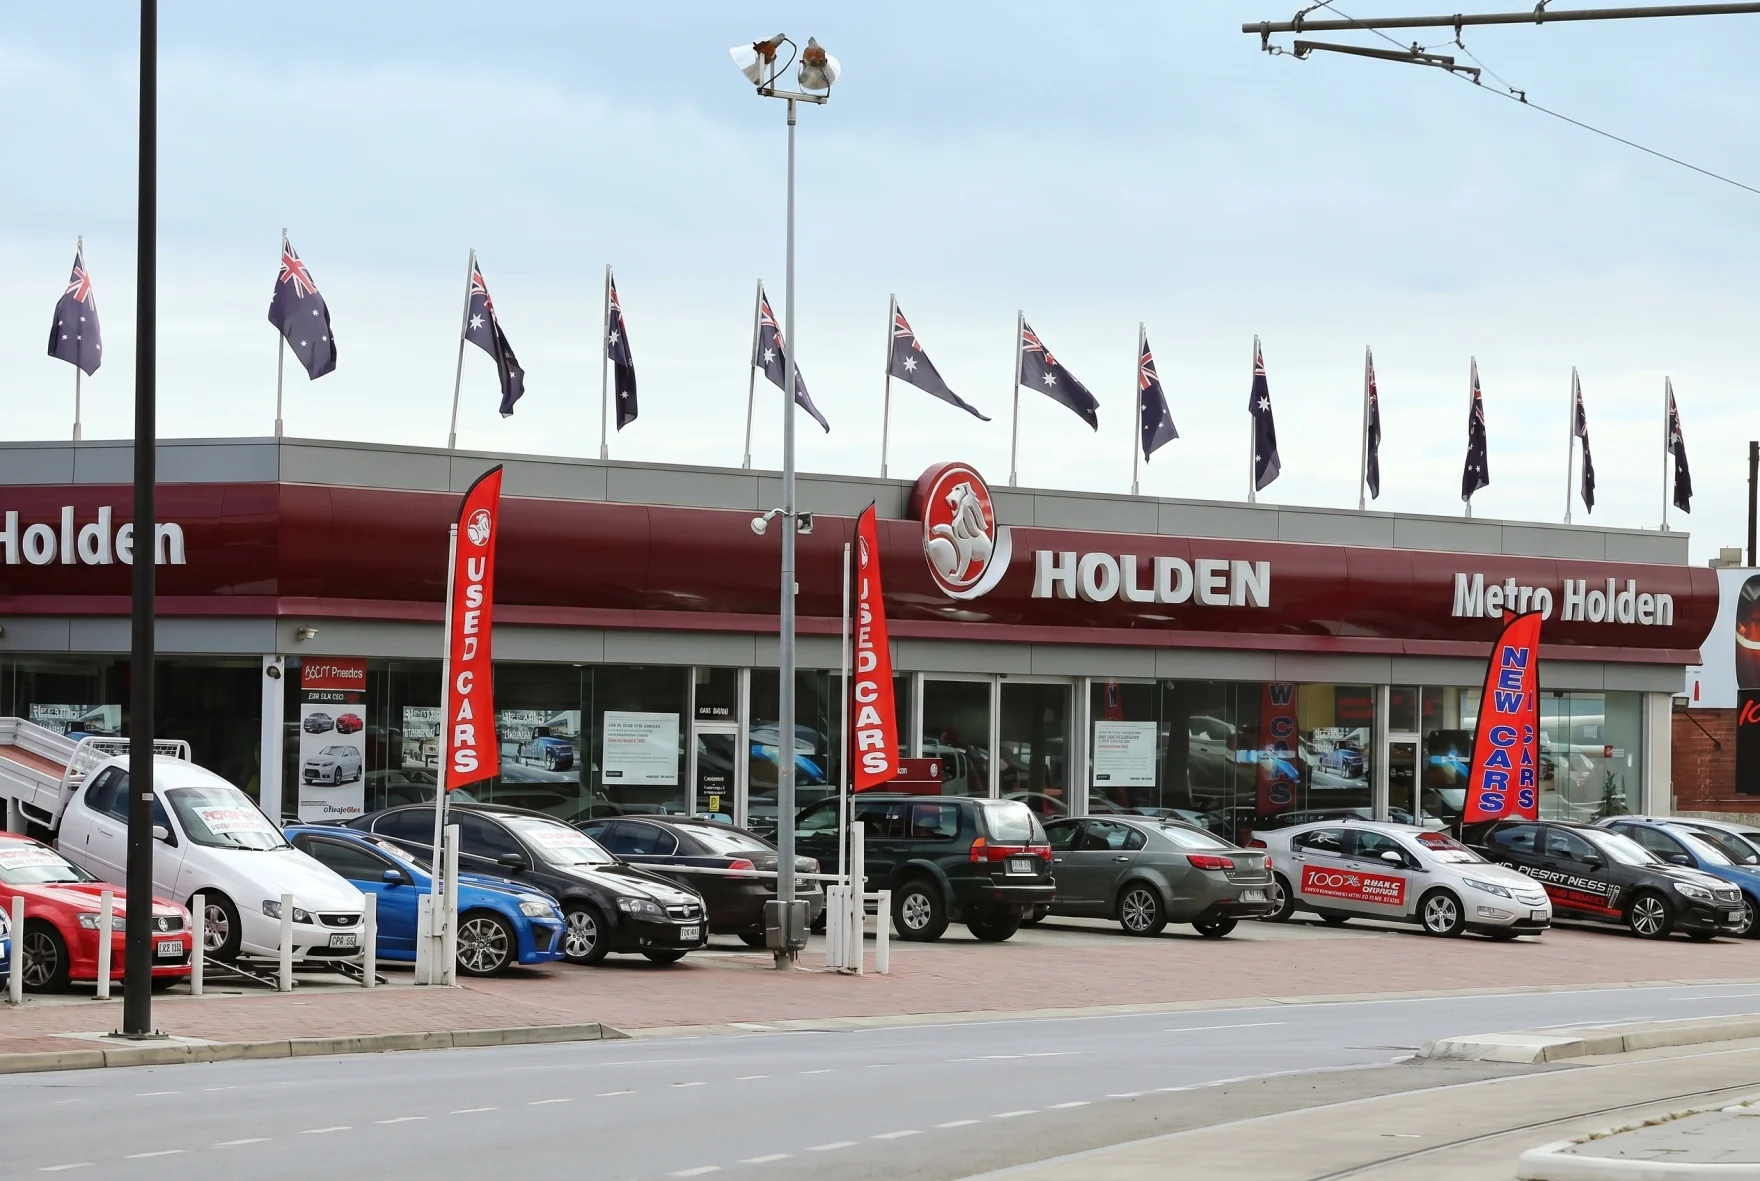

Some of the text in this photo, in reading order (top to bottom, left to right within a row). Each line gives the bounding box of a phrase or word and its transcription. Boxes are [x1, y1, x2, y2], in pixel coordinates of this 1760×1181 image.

[1031, 550, 1271, 608] HOLDEN
[1451, 573, 1674, 626] Metro Holden
[454, 556, 485, 773] USED CARS
[855, 680, 889, 774] CARS
[1477, 646, 1530, 813] NEW CARS
